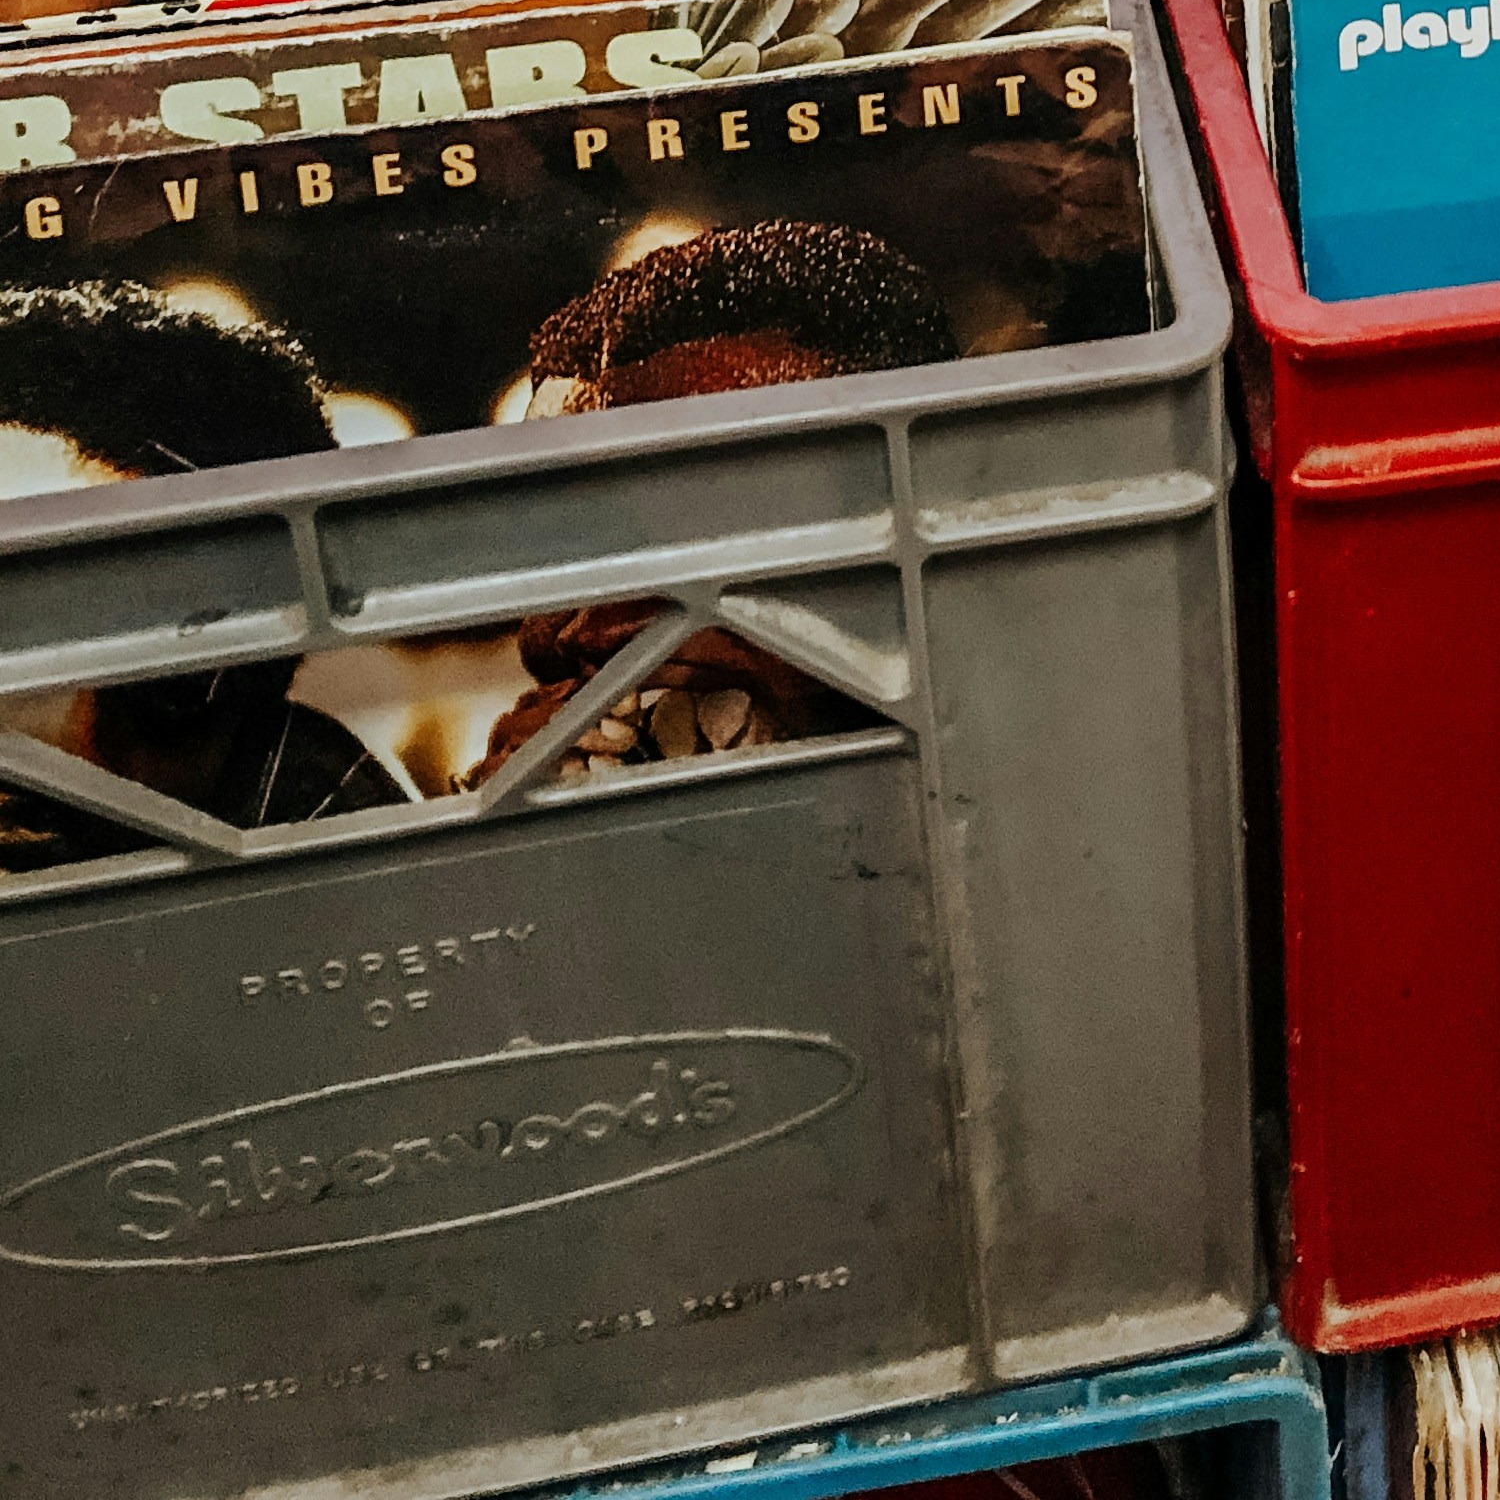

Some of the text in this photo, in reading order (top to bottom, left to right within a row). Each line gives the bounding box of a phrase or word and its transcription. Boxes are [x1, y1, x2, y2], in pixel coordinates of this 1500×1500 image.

[159, 28, 704, 142] STARS
[25, 63, 1100, 242] G VIBES PRESENTS
[240, 922, 537, 998] PROPERTY
[363, 989, 432, 1028] OF
